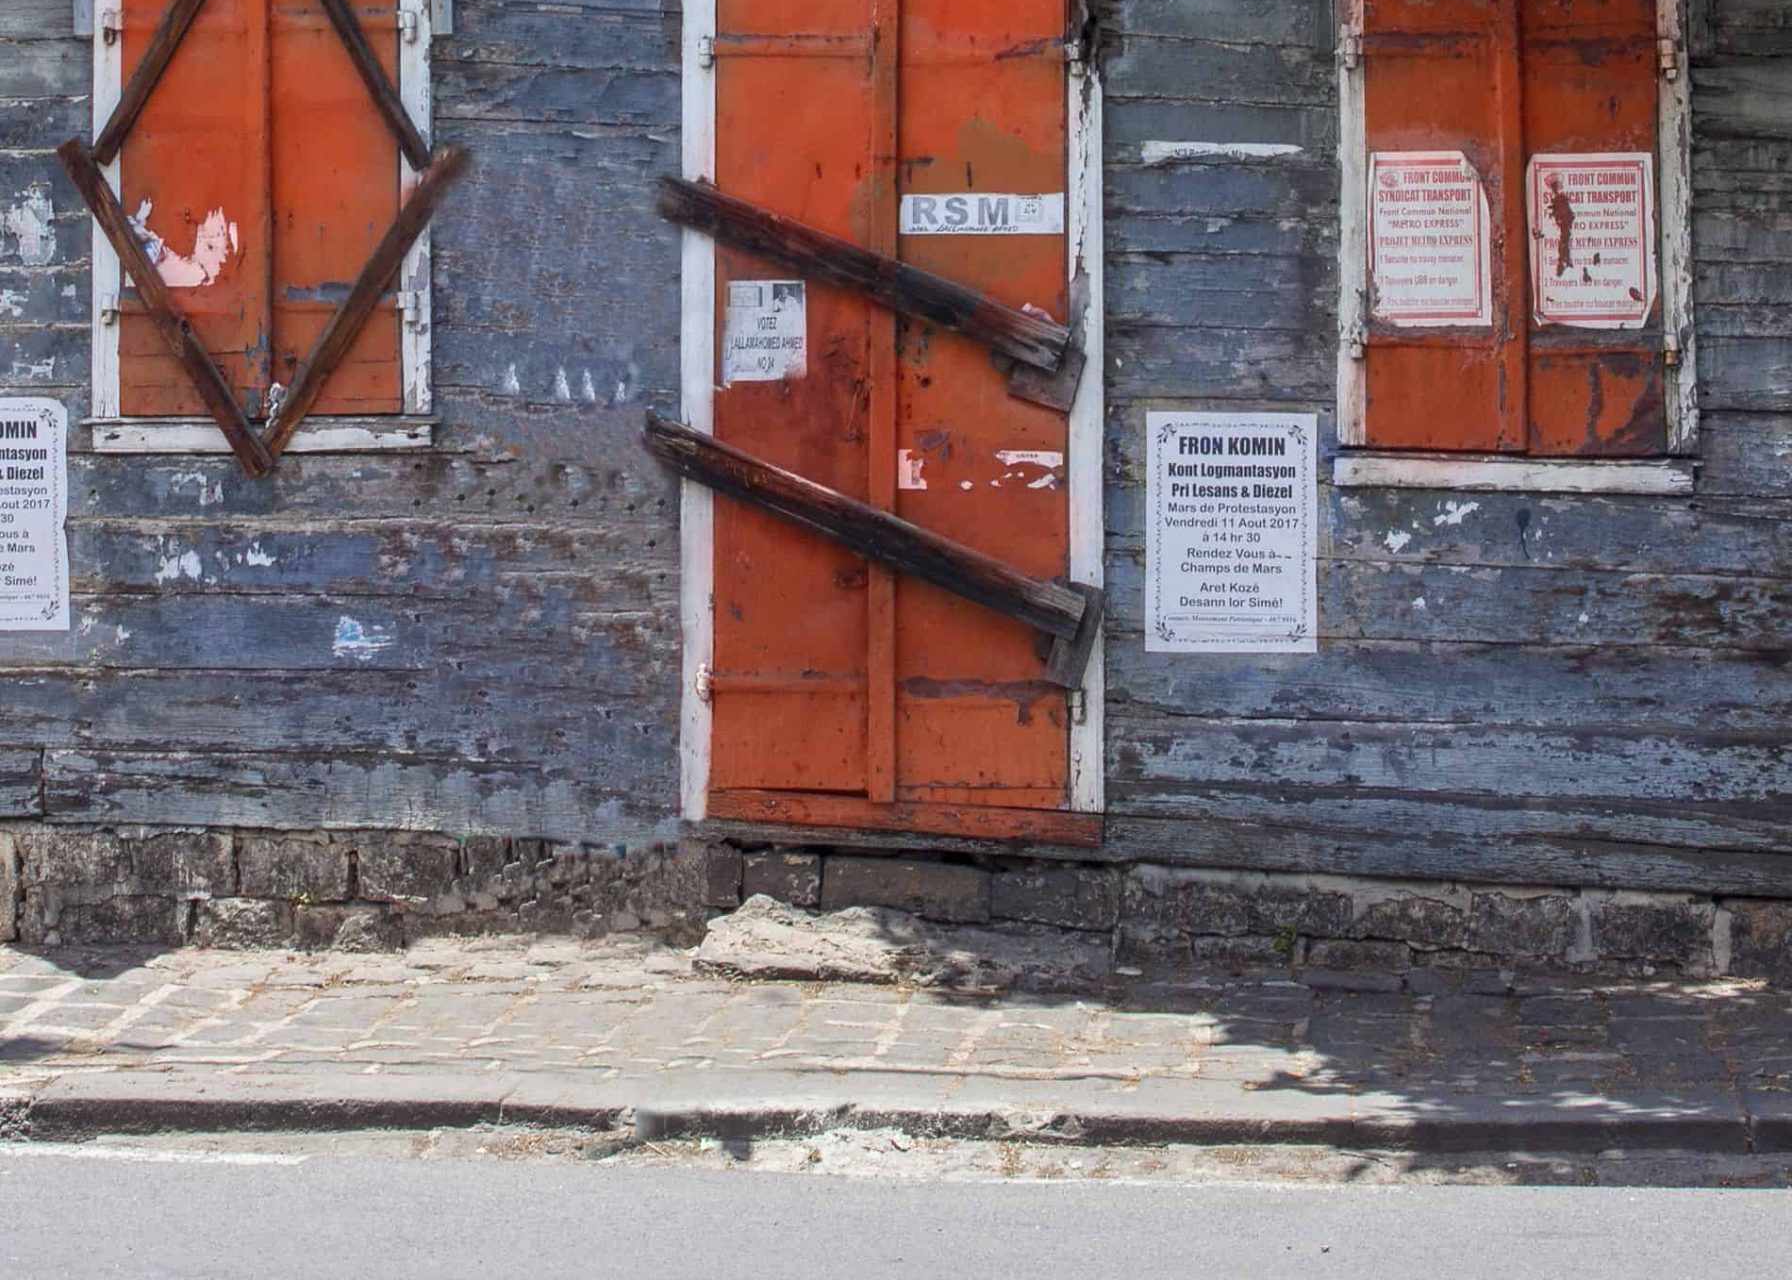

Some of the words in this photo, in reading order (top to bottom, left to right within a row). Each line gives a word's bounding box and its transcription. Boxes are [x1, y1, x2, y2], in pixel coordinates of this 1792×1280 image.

[1403, 171, 1430, 184] FRONT
[1568, 173, 1595, 186] FRONT
[1597, 172, 1636, 185] COMMUN
[1379, 189, 1420, 202] SYNDICAT
[1422, 188, 1471, 201] TRANSPORT
[1587, 190, 1636, 203] TRANSPORT
[912, 197, 1009, 226] RSM
[1380, 207, 1399, 216] Front
[1401, 207, 1436, 216] Commun
[1438, 206, 1472, 215] National
[1603, 208, 1637, 217] National
[1411, 235, 1437, 245] METRO
[1440, 234, 1473, 245] EXPRESS
[1604, 236, 1638, 247] EXPRESS
[757, 316, 777, 330] VOTEZ
[1179, 436, 1223, 456] FRON
[1228, 436, 1286, 456] KOMIN
[7, 466, 44, 480] Diezel
[1168, 462, 1198, 478] Kont
[1201, 462, 1296, 479] Logmantasyon
[1172, 483, 1189, 498] Pri
[1193, 483, 1238, 498] Lesans
[1241, 485, 1250, 498] &
[1253, 484, 1293, 499] Diezel
[23, 498, 50, 510] 2017
[1168, 502, 1197, 514] Mars
[1200, 502, 1215, 514] de
[1218, 502, 1296, 517] Protestasyon
[1165, 517, 1218, 528] Vendredi
[1222, 518, 1234, 528] 11
[1238, 518, 1266, 529] Aout
[1270, 518, 1299, 529] 2017
[1214, 532, 1227, 542] 14
[1230, 532, 1243, 543] hr
[1246, 532, 1261, 543] 30
[8, 543, 36, 553] Mars
[1187, 547, 1232, 559] Rendez
[1235, 548, 1265, 559] Vous
[1180, 562, 1231, 575] Champs
[1234, 563, 1249, 573] de
[1252, 563, 1282, 574] Mars
[4, 576, 37, 586] Simé!
[1200, 582, 1226, 593] Aret
[1229, 582, 1260, 593] Kozé
[1180, 596, 1226, 607] Desann
[1249, 597, 1283, 608] Simé!
